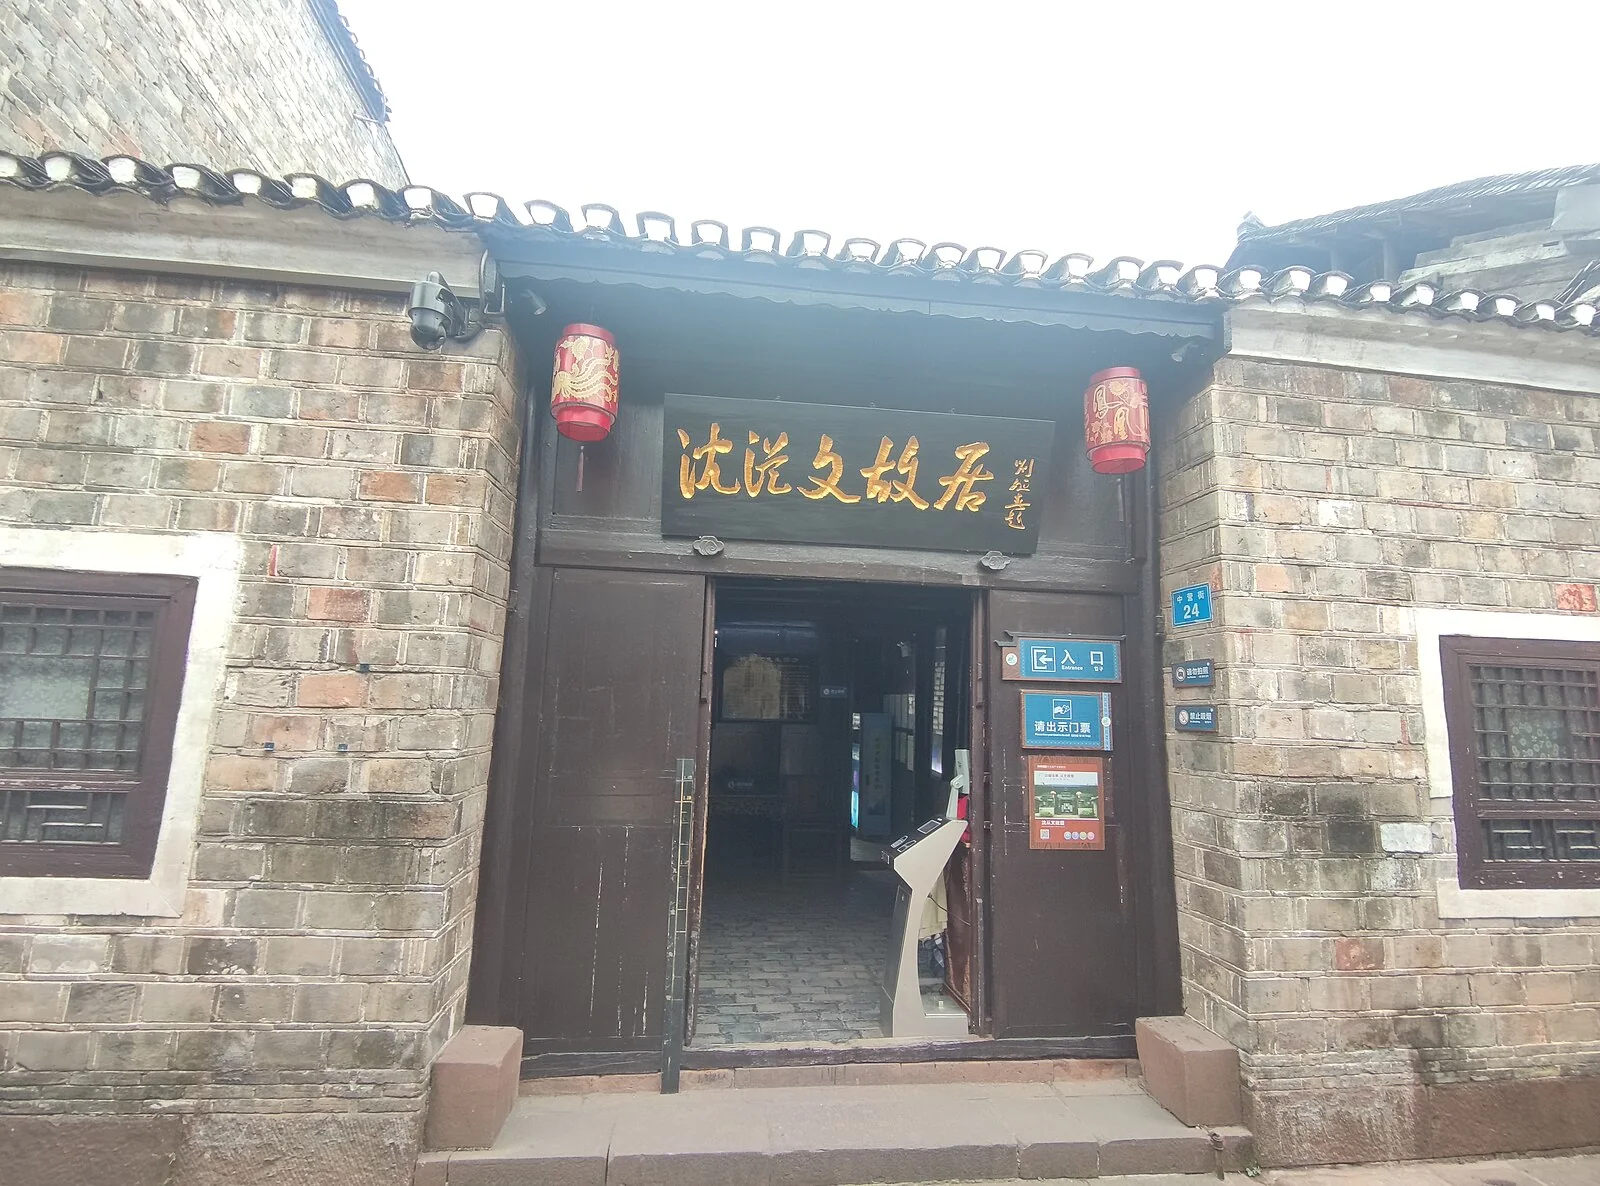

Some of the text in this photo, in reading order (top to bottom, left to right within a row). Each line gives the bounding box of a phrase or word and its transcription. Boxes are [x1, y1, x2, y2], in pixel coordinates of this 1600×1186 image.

[1183, 603, 1200, 619] 24
[1061, 649, 1104, 665] 入口
[1034, 720, 1091, 733] 请出示门票
